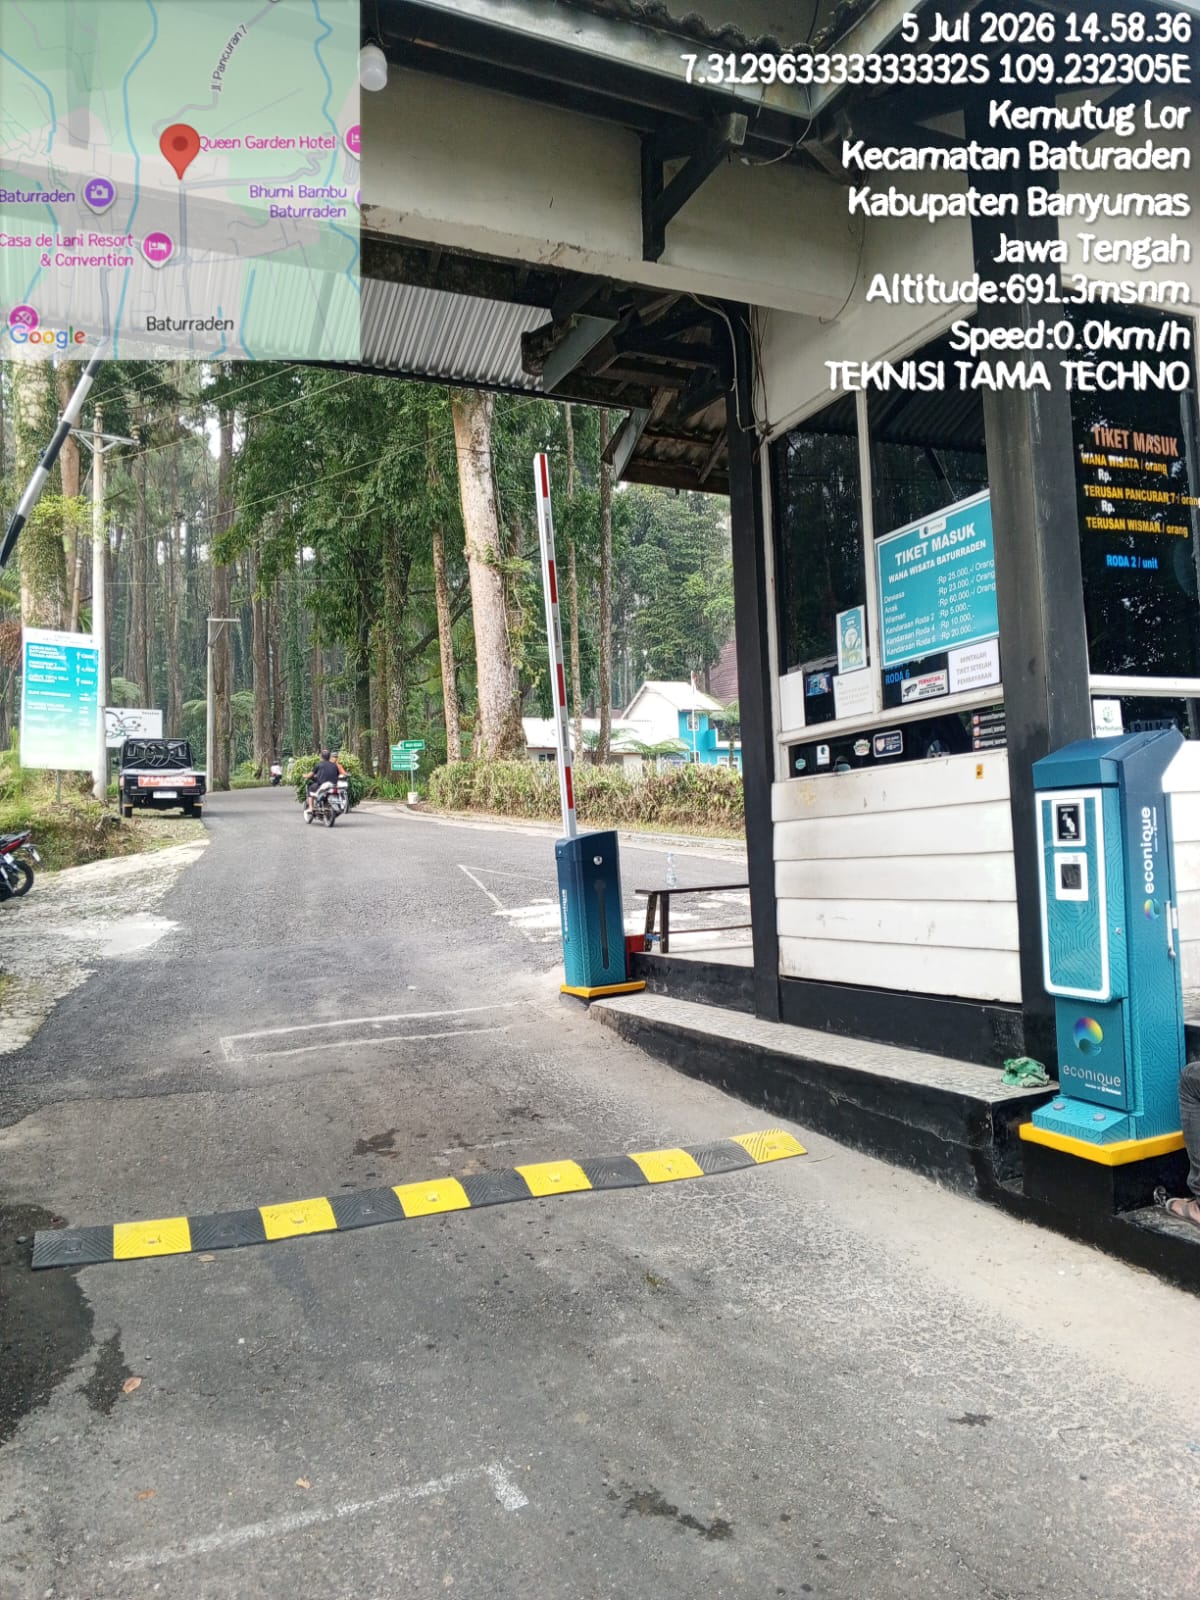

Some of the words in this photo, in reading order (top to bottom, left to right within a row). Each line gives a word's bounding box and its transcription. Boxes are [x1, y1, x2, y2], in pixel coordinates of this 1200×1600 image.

[1093, 426, 1129, 450] TIKET
[1132, 431, 1179, 457] MASUK
[1081, 452, 1107, 466] WANA
[1108, 454, 1140, 470] WISATA
[1144, 462, 1168, 476] orang
[1098, 468, 1112, 483] Rp.
[1084, 484, 1124, 500] TERUSAN
[1101, 500, 1116, 515] Rp.
[1086, 516, 1126, 530] TERUSAN
[1127, 518, 1160, 532] WISMAN
[1166, 525, 1188, 538] orang
[895, 542, 928, 566] TIKET
[932, 522, 976, 552] MASUK
[888, 570, 908, 584] WANA
[910, 560, 936, 576] WISATA
[936, 539, 986, 565] BATURRADEN
[1106, 554, 1130, 568] RODA
[1131, 556, 1136, 568] 2
[1142, 558, 1158, 568] unit
[886, 670, 904, 685] RODA
[1140, 806, 1154, 894] econique
[1063, 1064, 1120, 1086] econique
